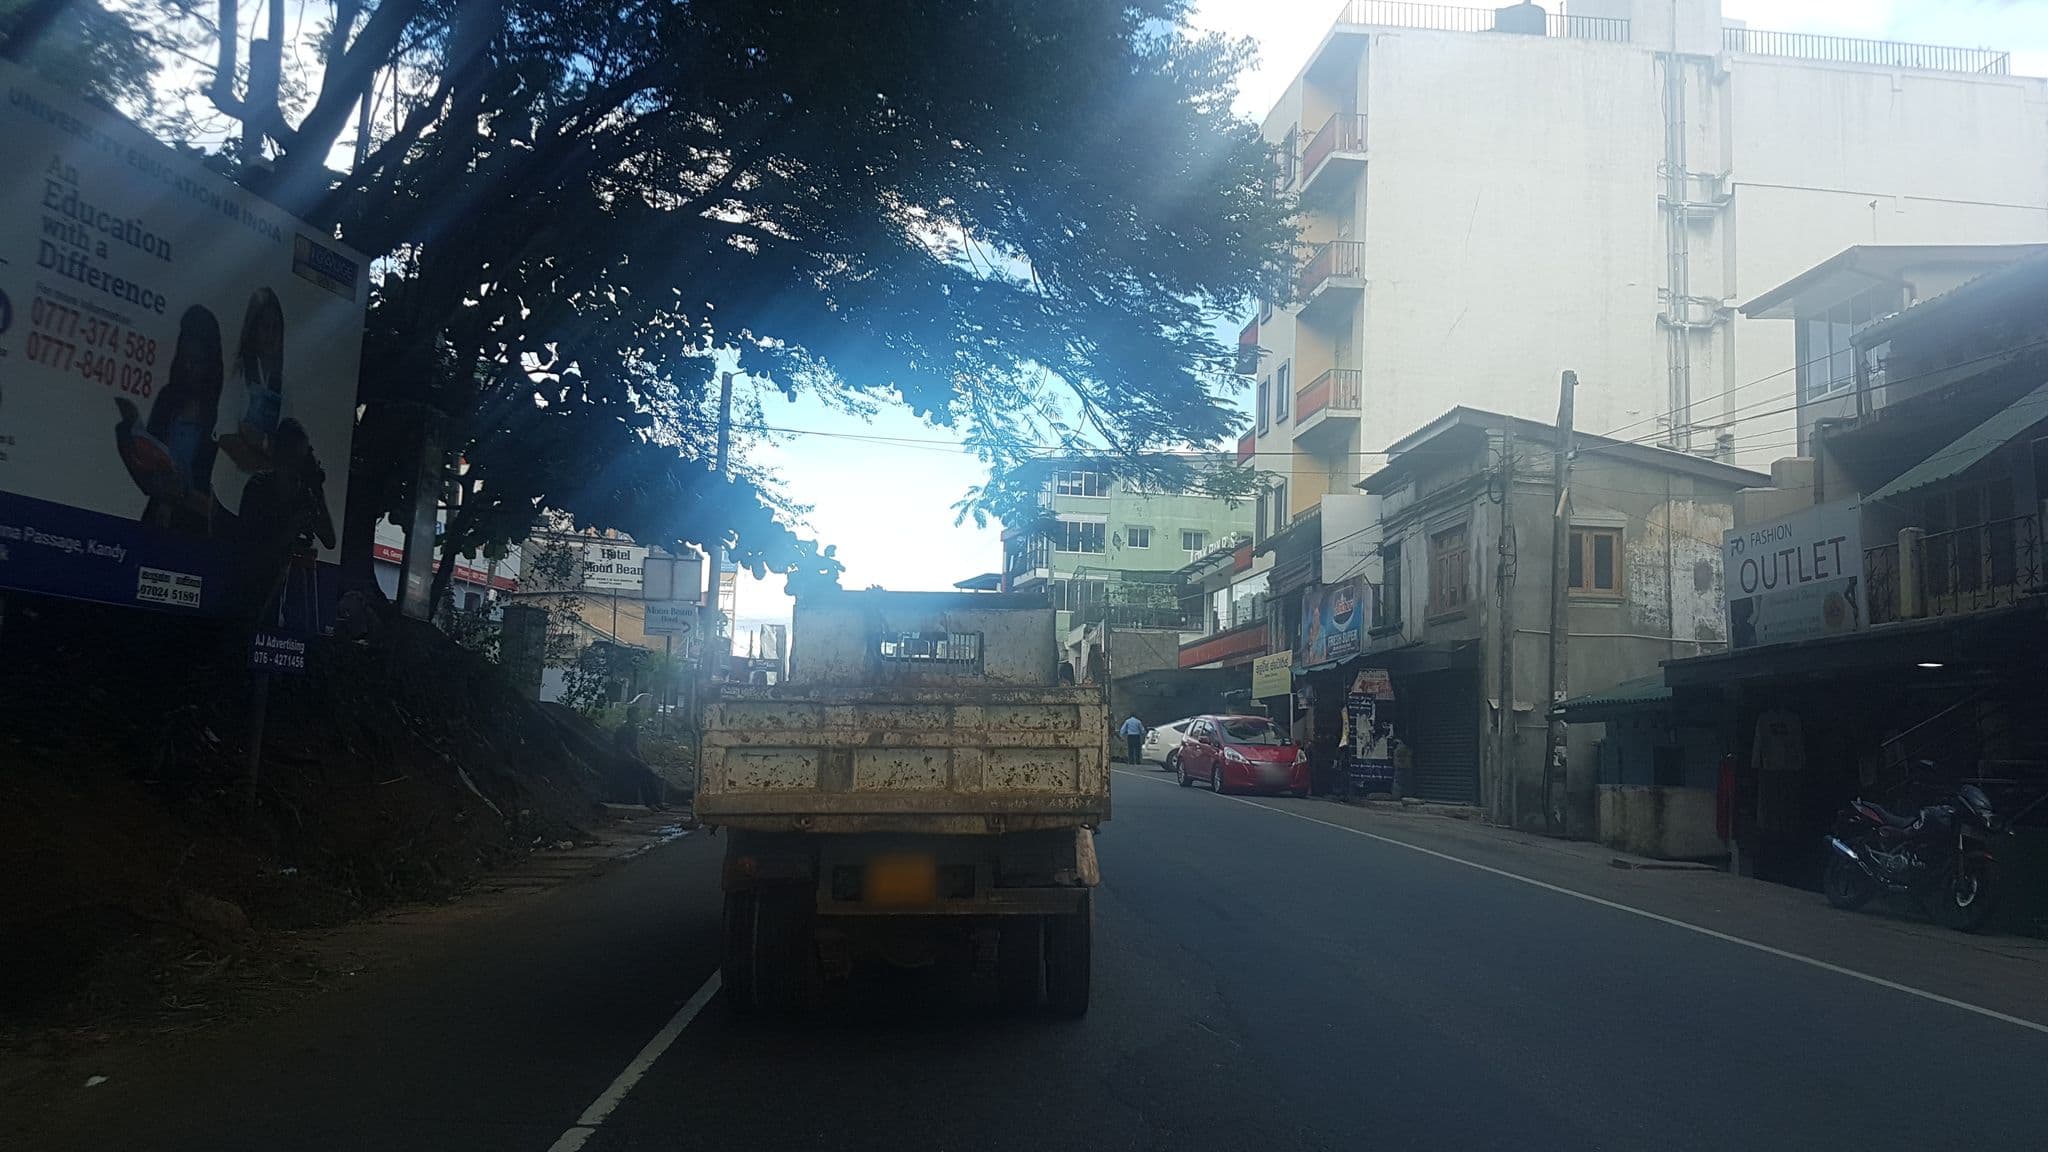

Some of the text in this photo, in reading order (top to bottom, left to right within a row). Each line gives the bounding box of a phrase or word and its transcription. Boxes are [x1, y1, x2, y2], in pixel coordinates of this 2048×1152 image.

[47, 154, 79, 186] An
[128, 150, 221, 211] EDUCATION
[223, 201, 240, 219] IN
[242, 208, 282, 243] INDIA
[42, 215, 108, 260] with a
[43, 177, 173, 262] Education
[37, 238, 166, 315] Difference
[32, 296, 120, 354] 0777-374
[125, 332, 157, 367] 588
[27, 331, 153, 399] 0777-840 028
[87, 538, 128, 563] Kandy
[601, 547, 631, 560] Hotel
[1750, 523, 1793, 548] FASHION
[1740, 536, 1847, 594] OUTLET
[646, 606, 693, 616] Moon Beam
[254, 651, 268, 665] 076
[255, 632, 305, 654] AJ Advertising
